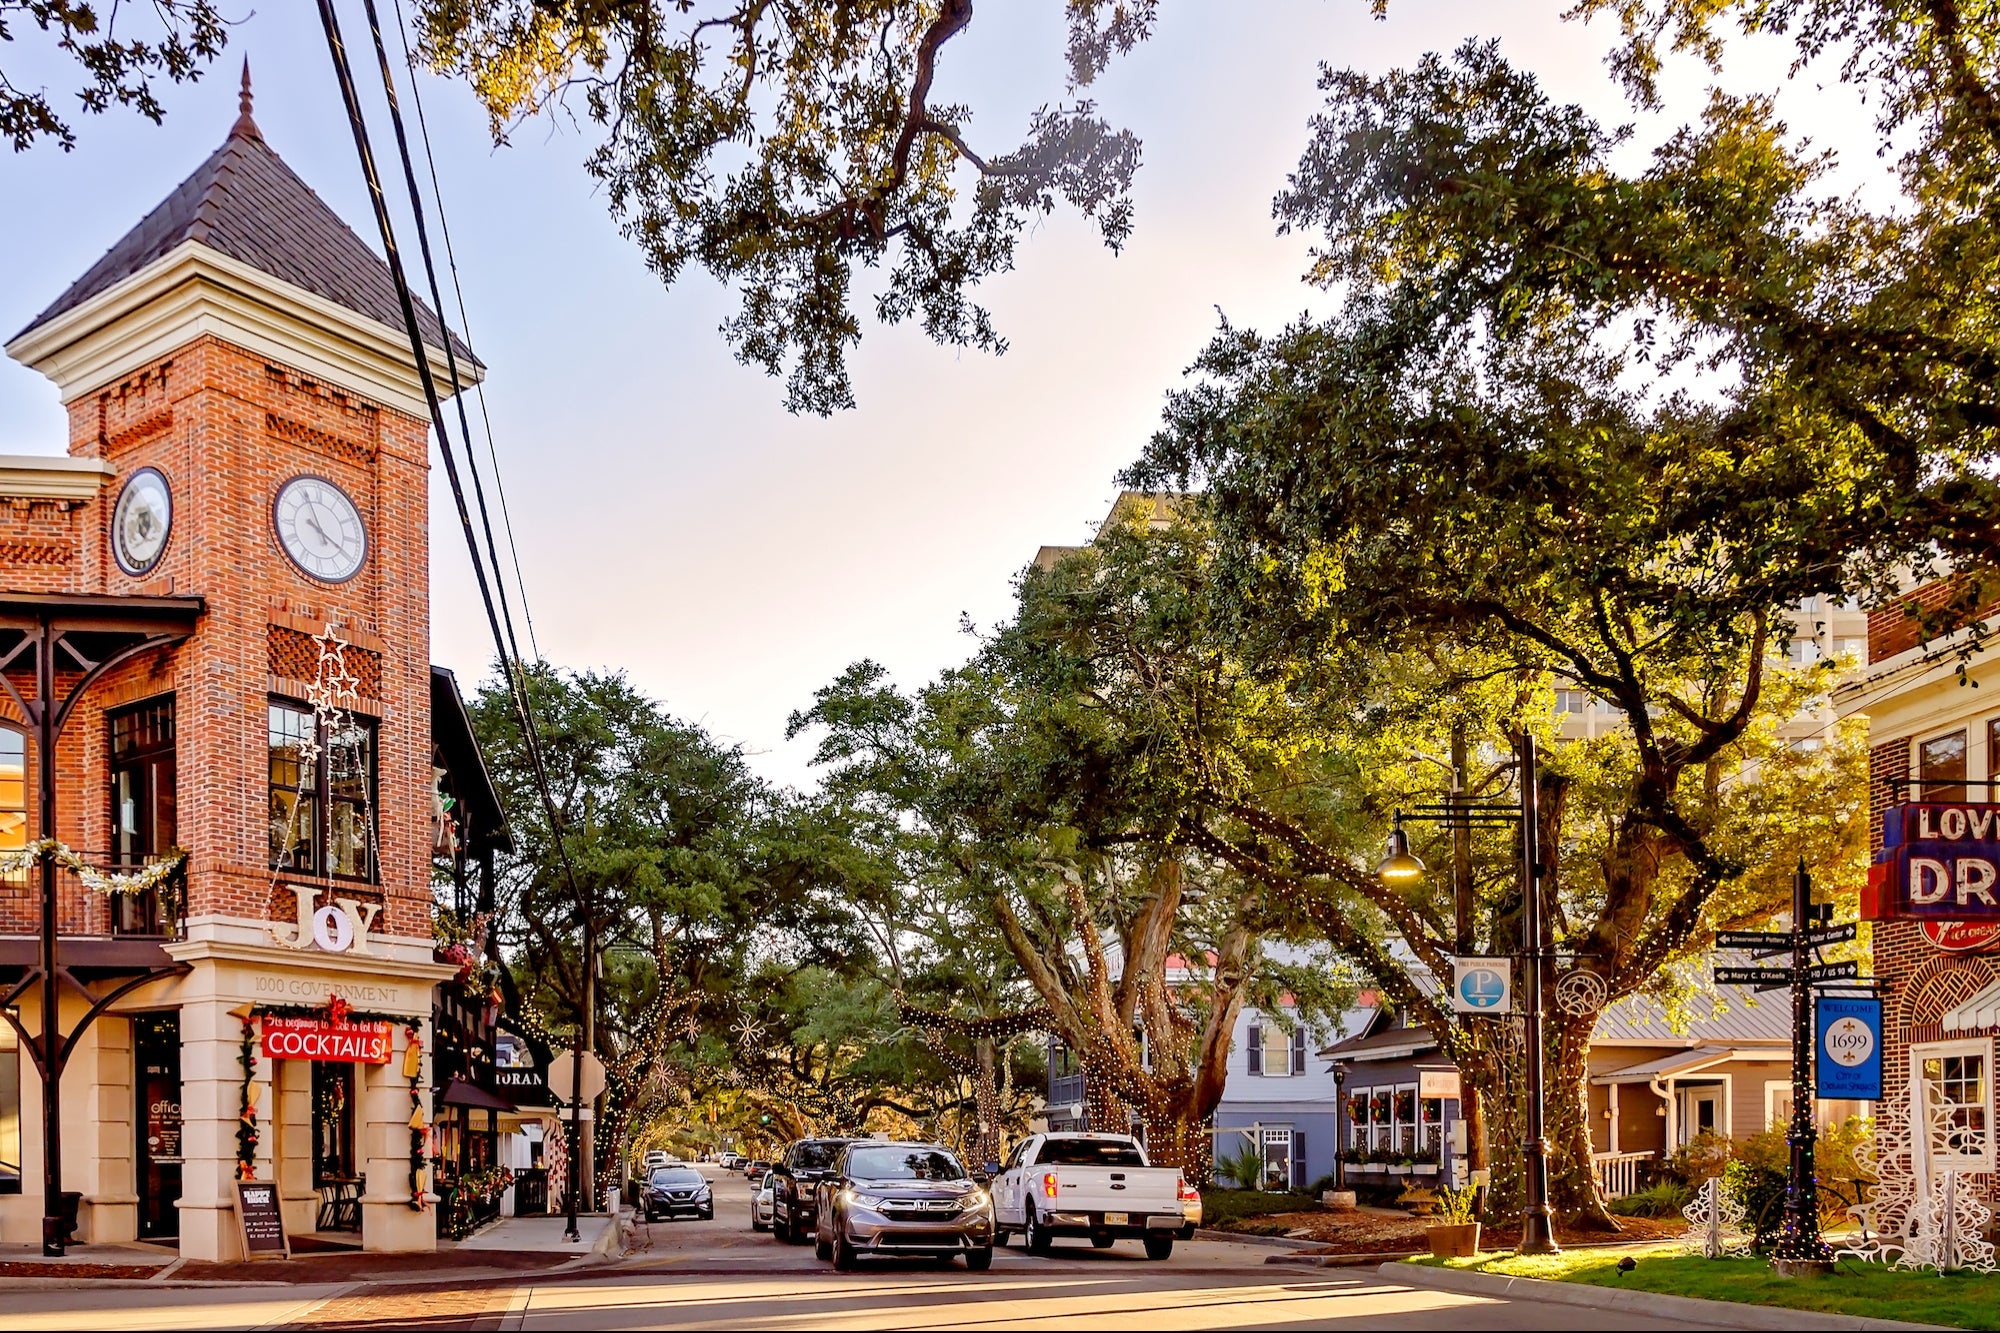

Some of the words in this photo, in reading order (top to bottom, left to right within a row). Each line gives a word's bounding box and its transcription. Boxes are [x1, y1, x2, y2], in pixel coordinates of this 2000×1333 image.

[1910, 858, 1998, 905] DR
[272, 885, 382, 956] JOY
[1826, 929, 1844, 939] Center
[1474, 971, 1493, 994] P
[1731, 971, 1747, 980] Mary
[256, 977, 284, 993] 1000
[289, 980, 398, 1002] GOVERNMENT
[1823, 1003, 1873, 1013] WELCOME
[268, 1032, 386, 1059] COCKTAILS!
[1831, 1033, 1868, 1050] 1699
